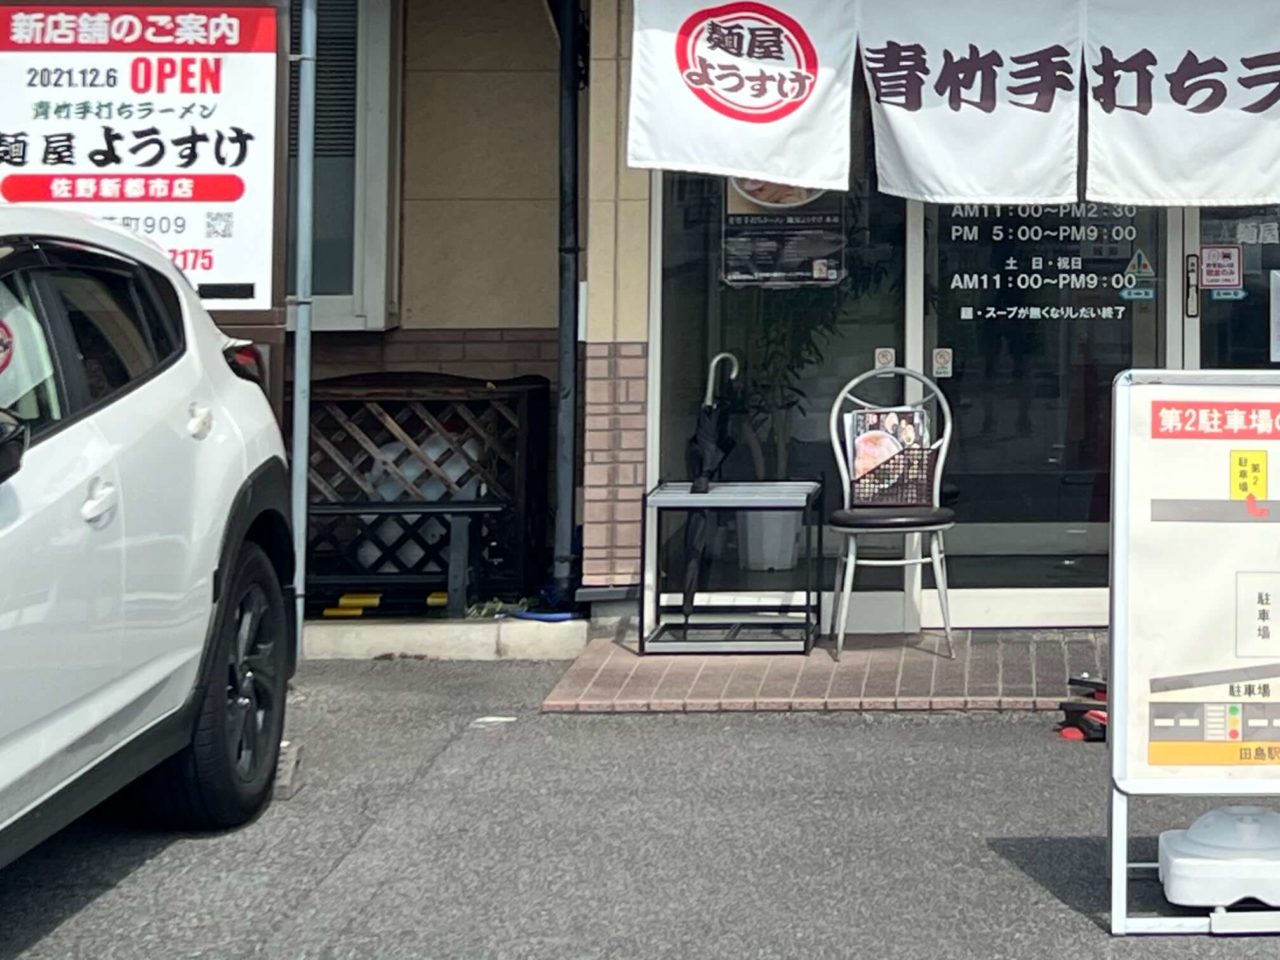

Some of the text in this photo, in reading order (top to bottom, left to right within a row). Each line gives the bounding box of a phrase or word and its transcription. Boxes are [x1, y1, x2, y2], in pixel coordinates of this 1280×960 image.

[10, 12, 240, 46] 新店舗のご案内
[706, 22, 786, 60] 麺屋
[27, 57, 222, 94] 2021.12.6 OPEN
[688, 61, 813, 99] ようすけ
[32, 100, 217, 120] 青竹手打ちラーメン
[88, 126, 255, 168] ようすけ
[50, 178, 195, 198] 佐野新都市店
[102, 216, 187, 234] 町909
[1257, 592, 1271, 640] 駐車場
[1229, 683, 1271, 698] 駐車場
